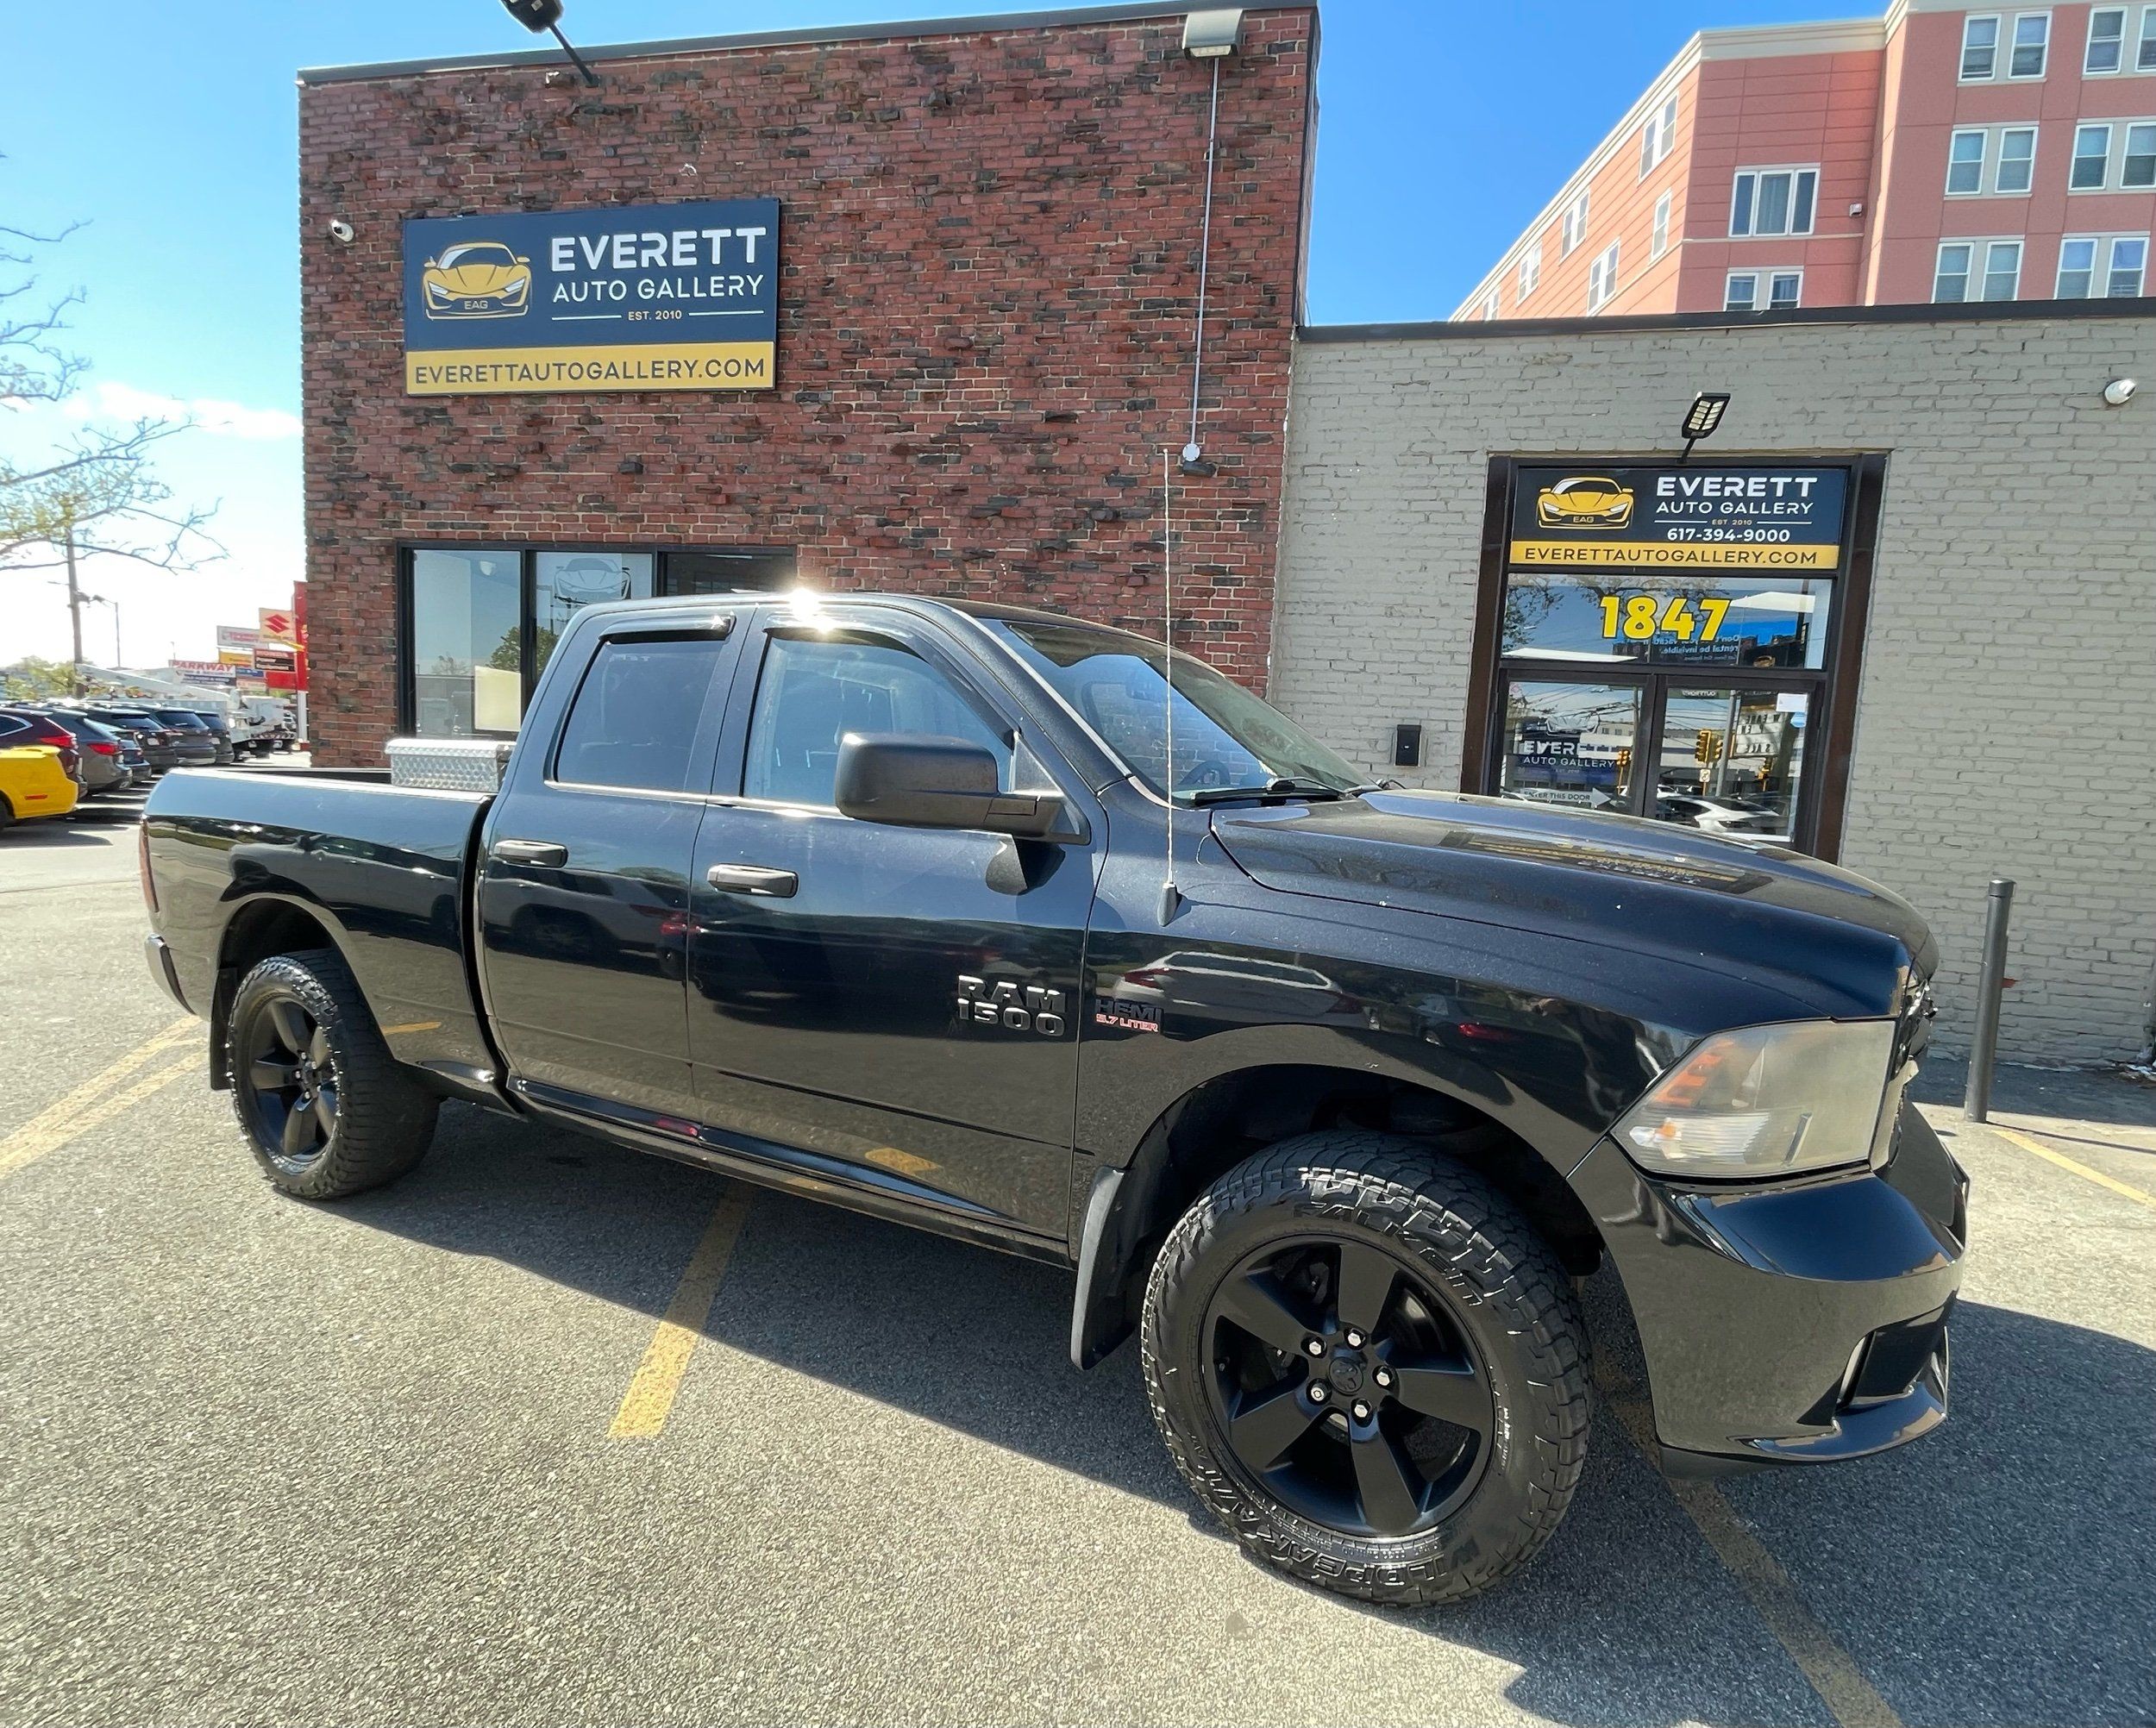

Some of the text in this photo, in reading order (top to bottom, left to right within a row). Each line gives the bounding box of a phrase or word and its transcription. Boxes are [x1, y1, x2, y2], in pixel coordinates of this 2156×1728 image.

[550, 227, 767, 272] EVERETT
[552, 274, 764, 304] AUTO GALLERY
[463, 300, 489, 310] EAG
[628, 310, 682, 321] EST. 2010
[415, 358, 765, 385] EVERETTAUTOGALLERY.COM
[1656, 477, 1818, 498] EVERETT
[1656, 501, 1814, 515] AUTO GALLERY
[1667, 528, 1790, 542] 617-394-9000
[1525, 548, 1817, 564] EVERETTAUTOGALLERY.COM
[1600, 595, 1731, 642] 1847
[172, 661, 232, 671] PARKWAY
[1523, 756, 1615, 767] AUTO GALLERY
[957, 974, 1066, 1013] RAM
[957, 999, 1065, 1036] 1500
[1095, 999, 1163, 1023] HEMI
[1095, 1013, 1158, 1032] 5.7 LITER
